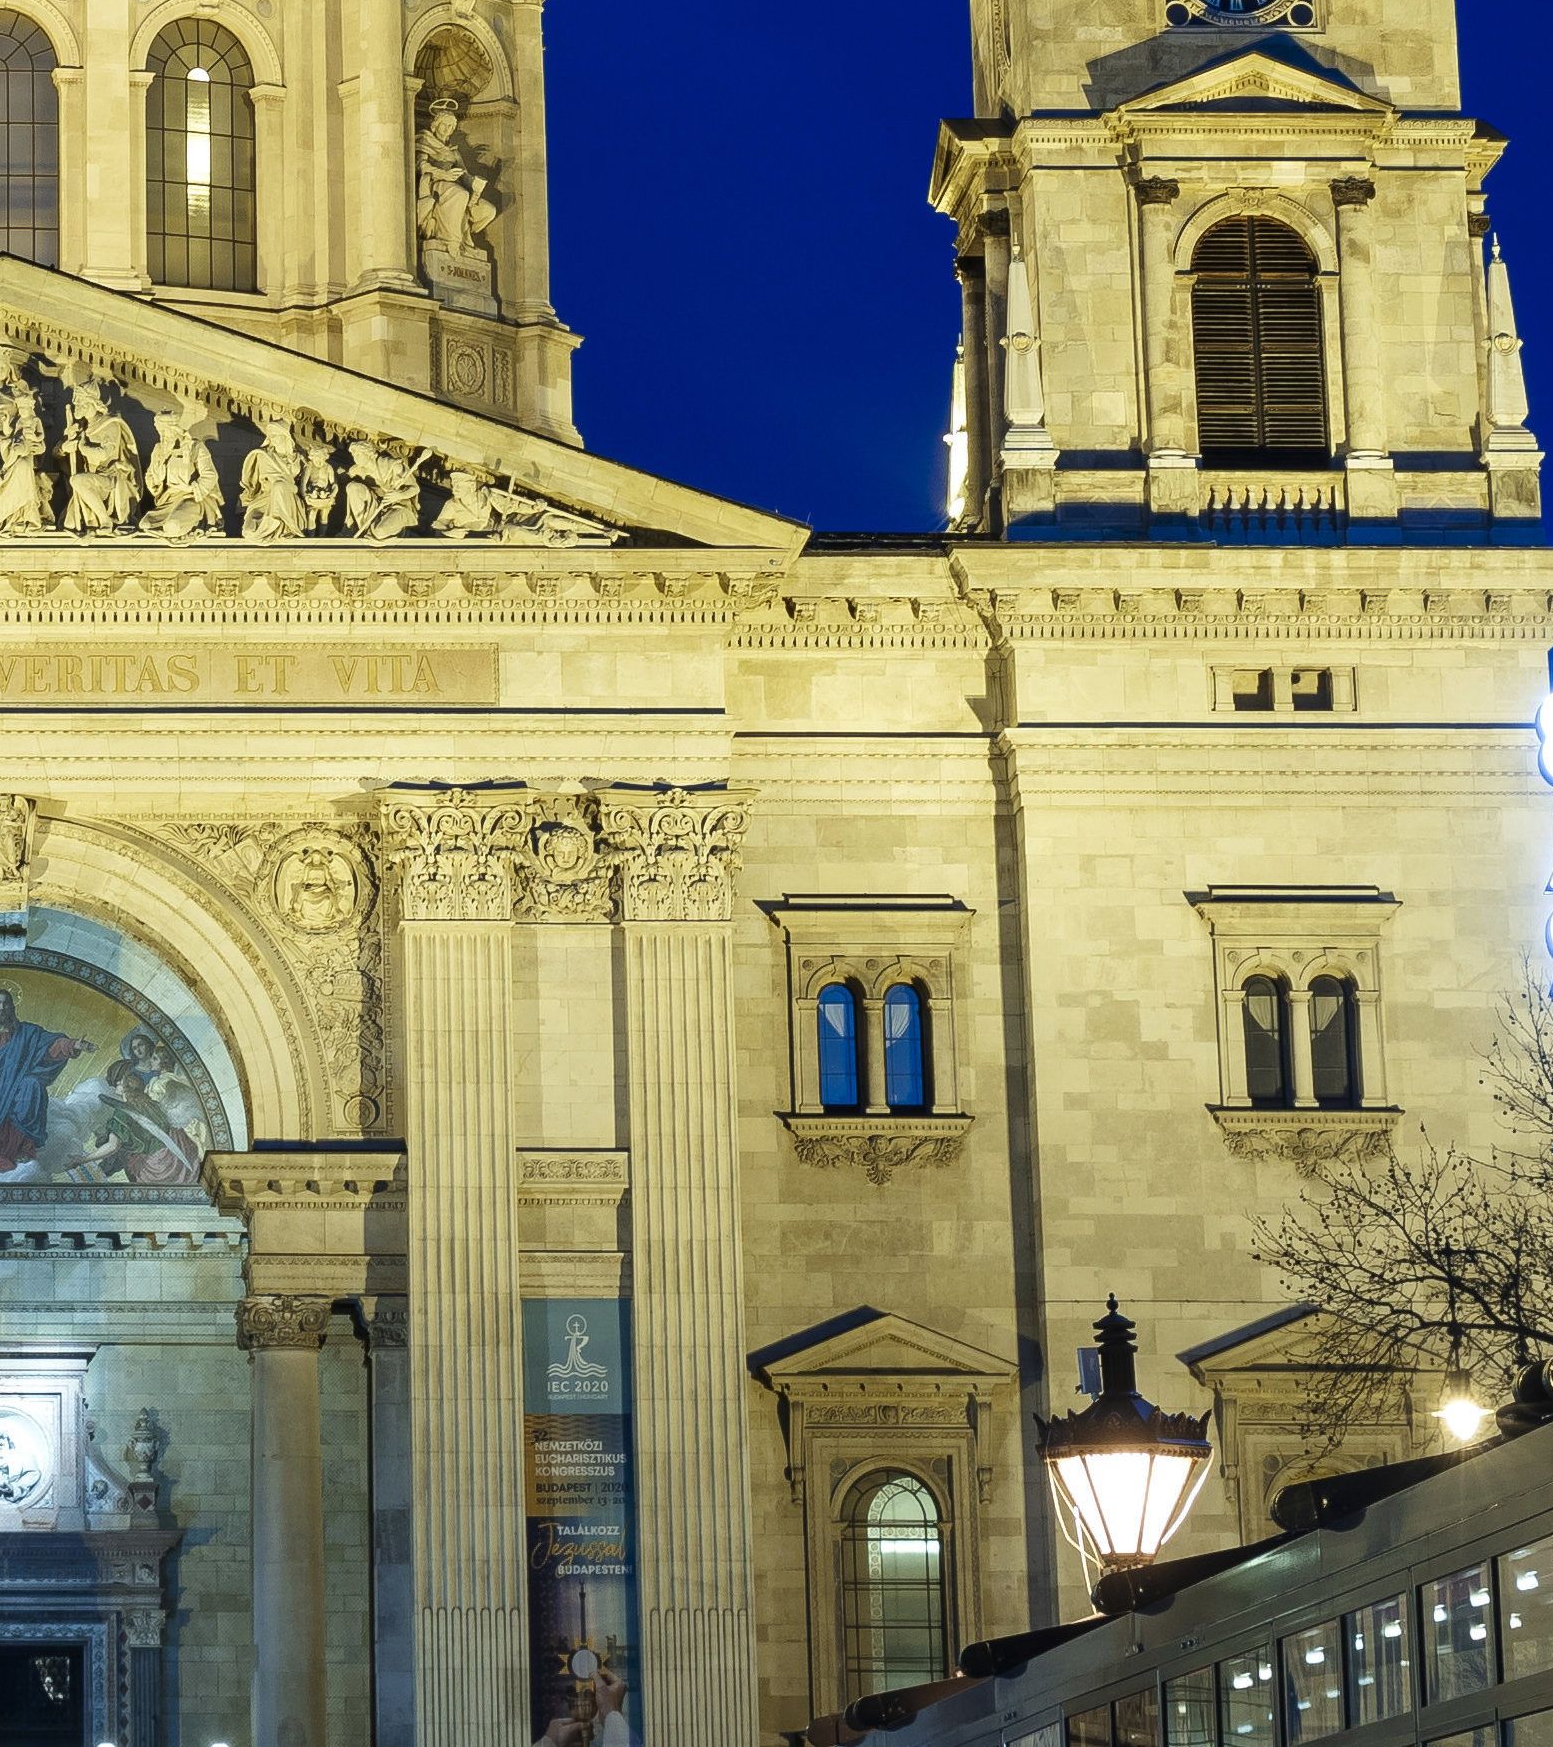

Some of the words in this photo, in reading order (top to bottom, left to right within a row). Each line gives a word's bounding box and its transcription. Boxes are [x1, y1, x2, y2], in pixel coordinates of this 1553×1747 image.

[233, 653, 297, 694] ET
[326, 653, 445, 695] VITA
[547, 1381, 570, 1393] IEC
[574, 1380, 609, 1393] 2020
[535, 1439, 603, 1452] NEMZETKÖZI
[535, 1453, 628, 1465] EUCHARISZTIKUS
[535, 1466, 616, 1477] KONGRESSZUS
[536, 1483, 592, 1493] BUDAPEST
[536, 1496, 595, 1507] szeptember
[557, 1523, 621, 1536] TALÁLKOZZ
